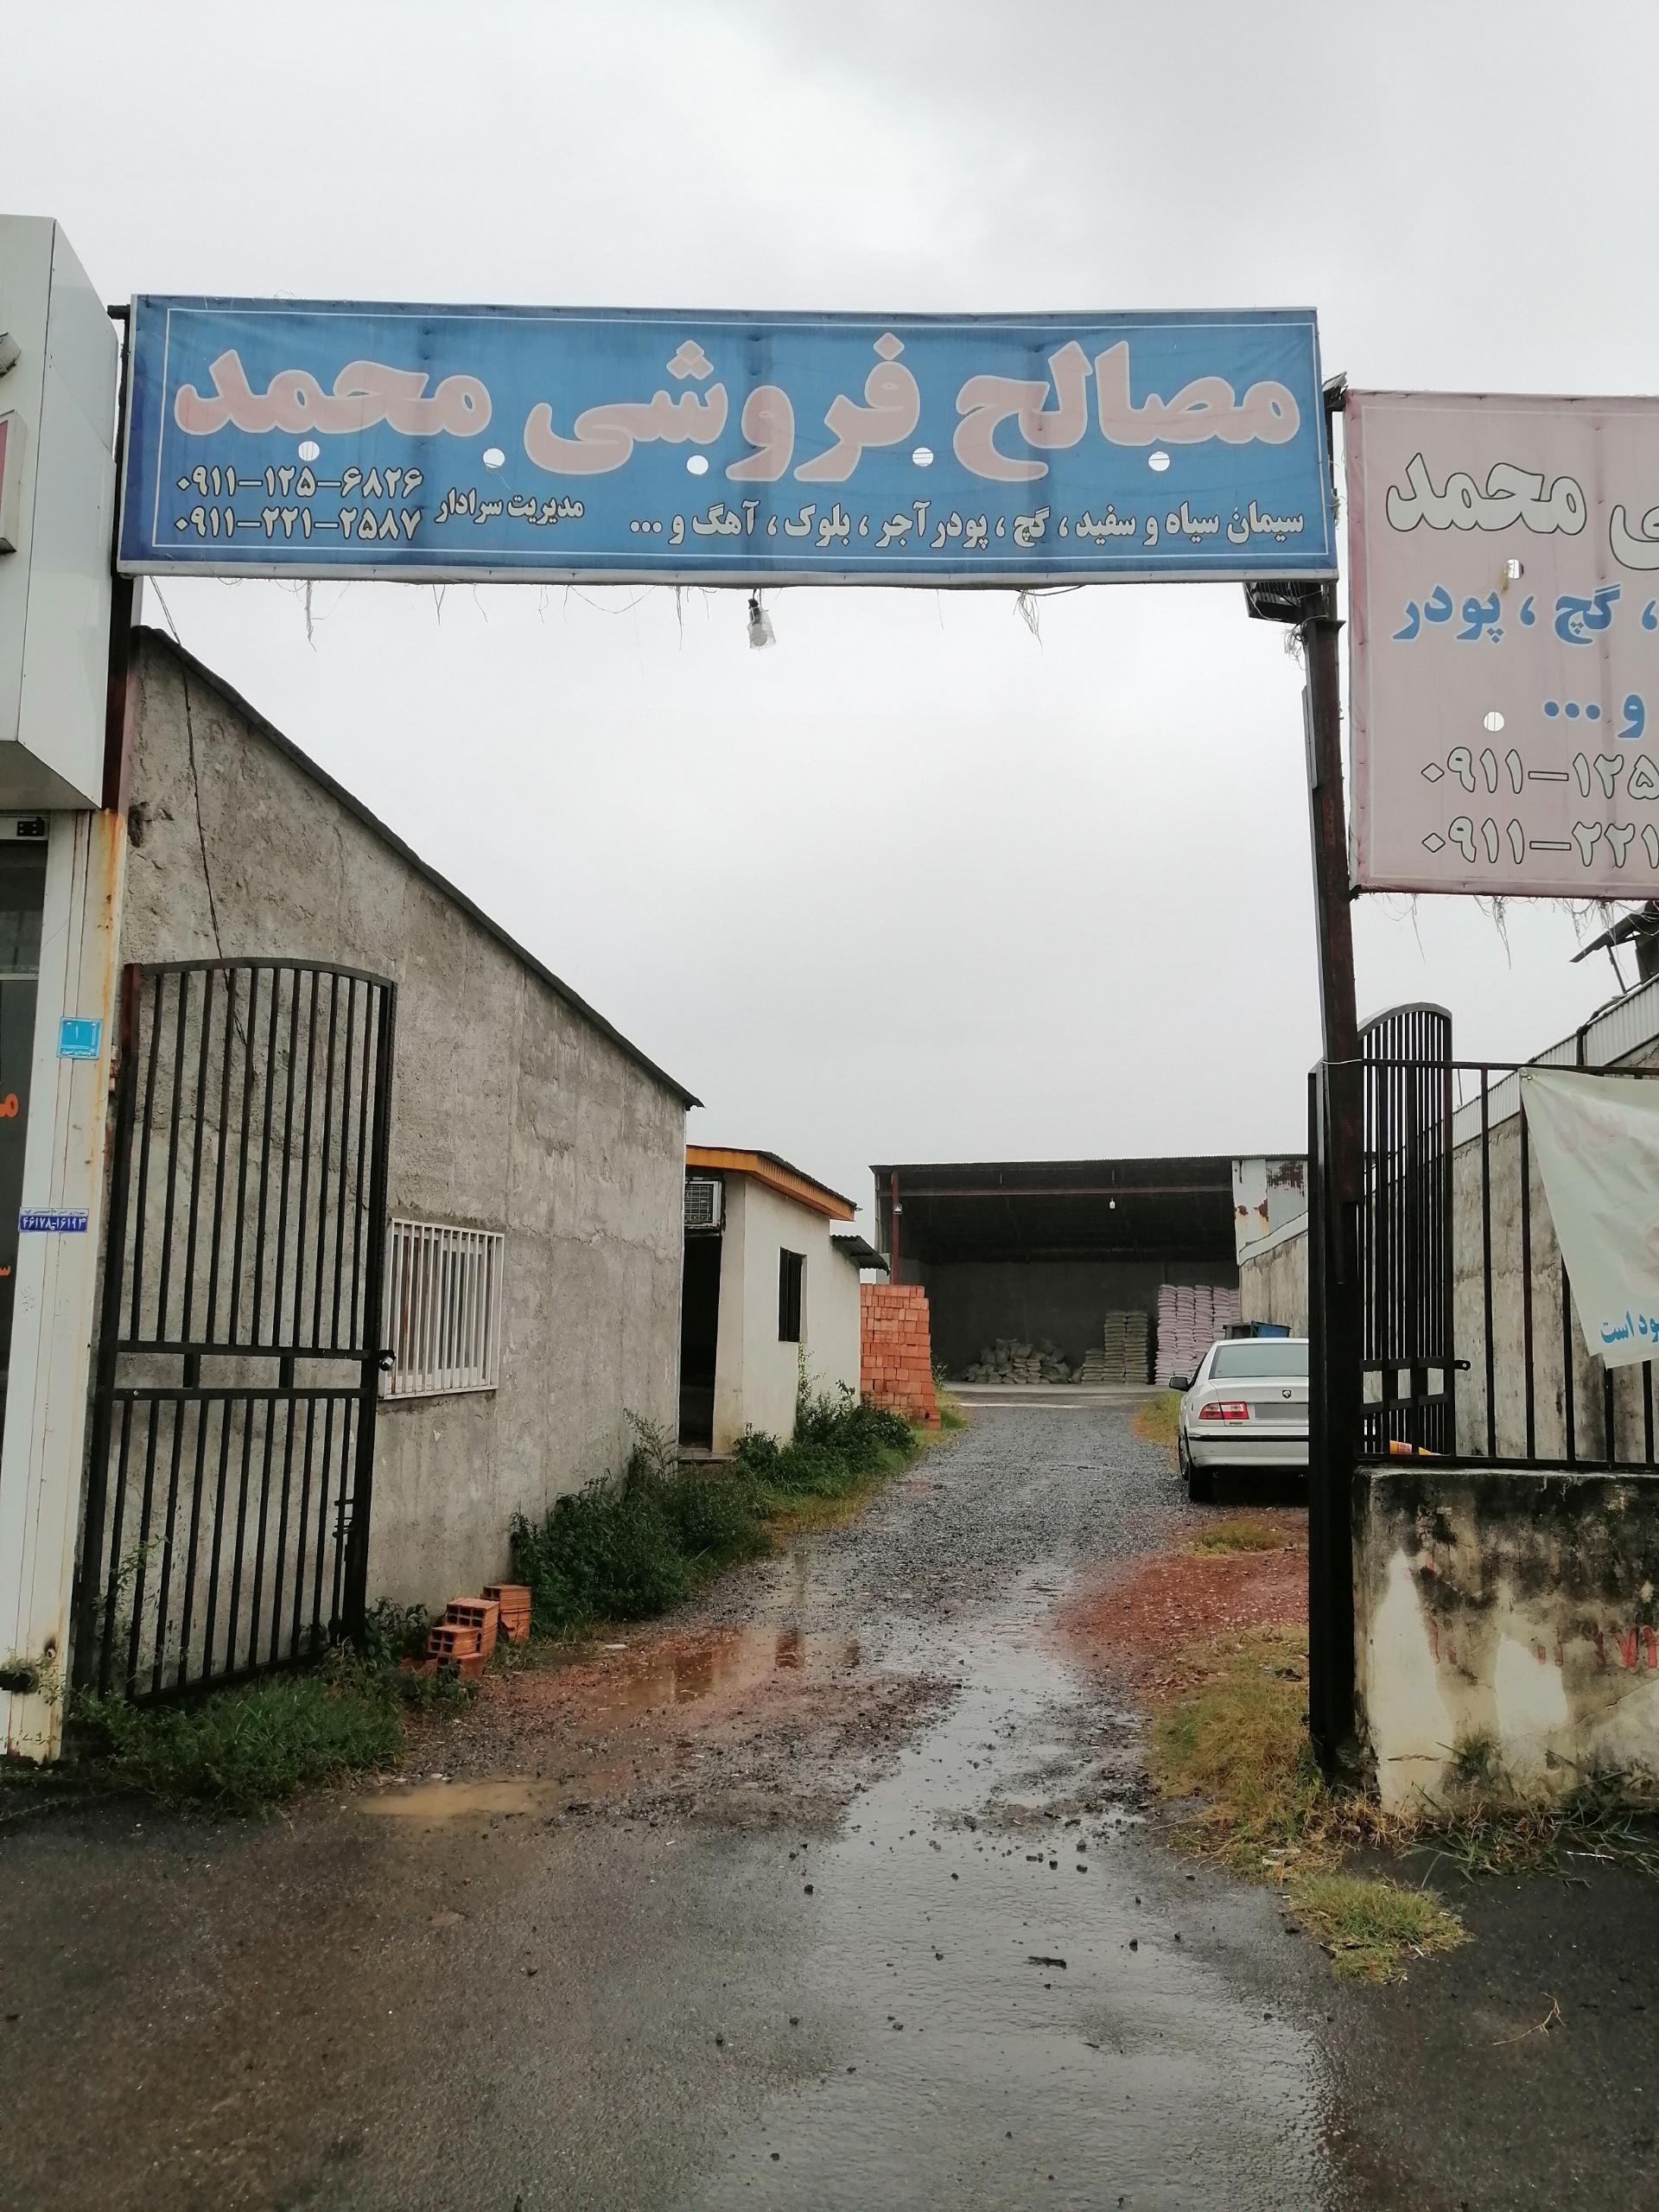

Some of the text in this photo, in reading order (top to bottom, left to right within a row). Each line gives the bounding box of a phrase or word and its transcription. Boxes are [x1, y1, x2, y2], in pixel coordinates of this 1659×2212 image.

[175, 332, 1300, 481] مصالح فروشی محمد
[507, 494, 585, 524] مدیریت
[1386, 452, 1586, 535] محمد
[668, 515, 685, 544] و
[930, 512, 988, 550] پودر
[1143, 515, 1159, 546] و
[1165, 500, 1220, 543] سیاه
[1226, 500, 1304, 544] سیمان
[1392, 585, 1502, 644] پودر
[1618, 694, 1645, 739] و
[1600, 1310, 1635, 1344] است
